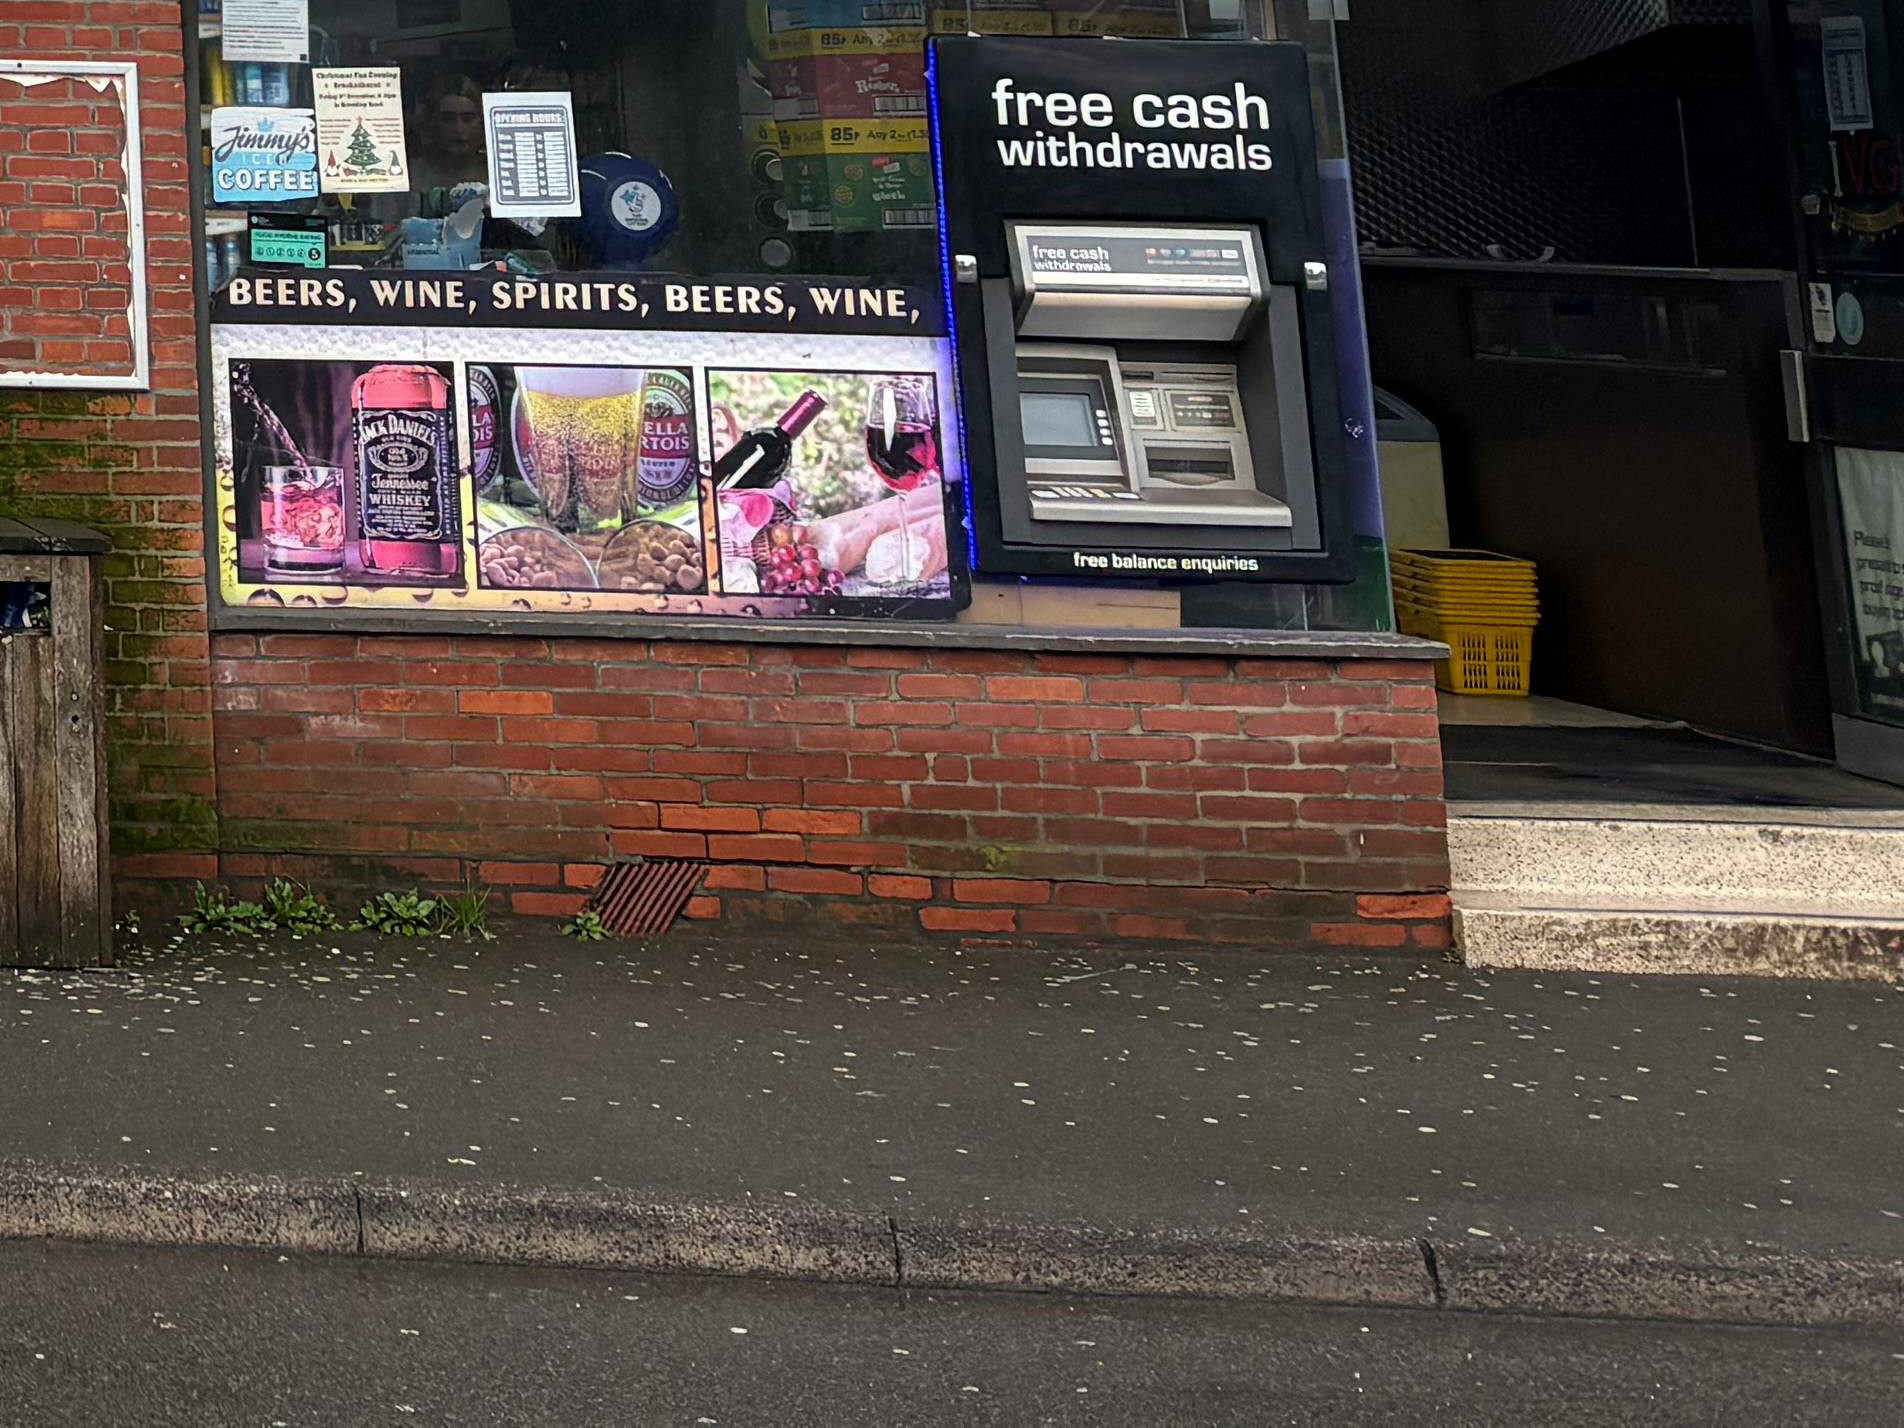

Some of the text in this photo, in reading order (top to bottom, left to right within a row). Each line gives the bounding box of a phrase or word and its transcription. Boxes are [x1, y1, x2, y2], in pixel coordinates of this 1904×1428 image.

[991, 77, 1270, 129] free cash
[215, 126, 311, 166] Jimmy's
[996, 130, 1273, 171] withdrawals
[217, 168, 315, 191] COFFEE
[1032, 245, 1109, 260] free cash
[1034, 259, 1112, 272] withdrawals
[228, 277, 921, 325] BEERS, WINE, SPIRITS, BEERS, WINE,
[640, 436, 690, 451] RTOIS
[371, 473, 429, 491] Tennessee
[369, 494, 432, 507] WHISKEY
[1073, 551, 1259, 574] free balance enquiries
